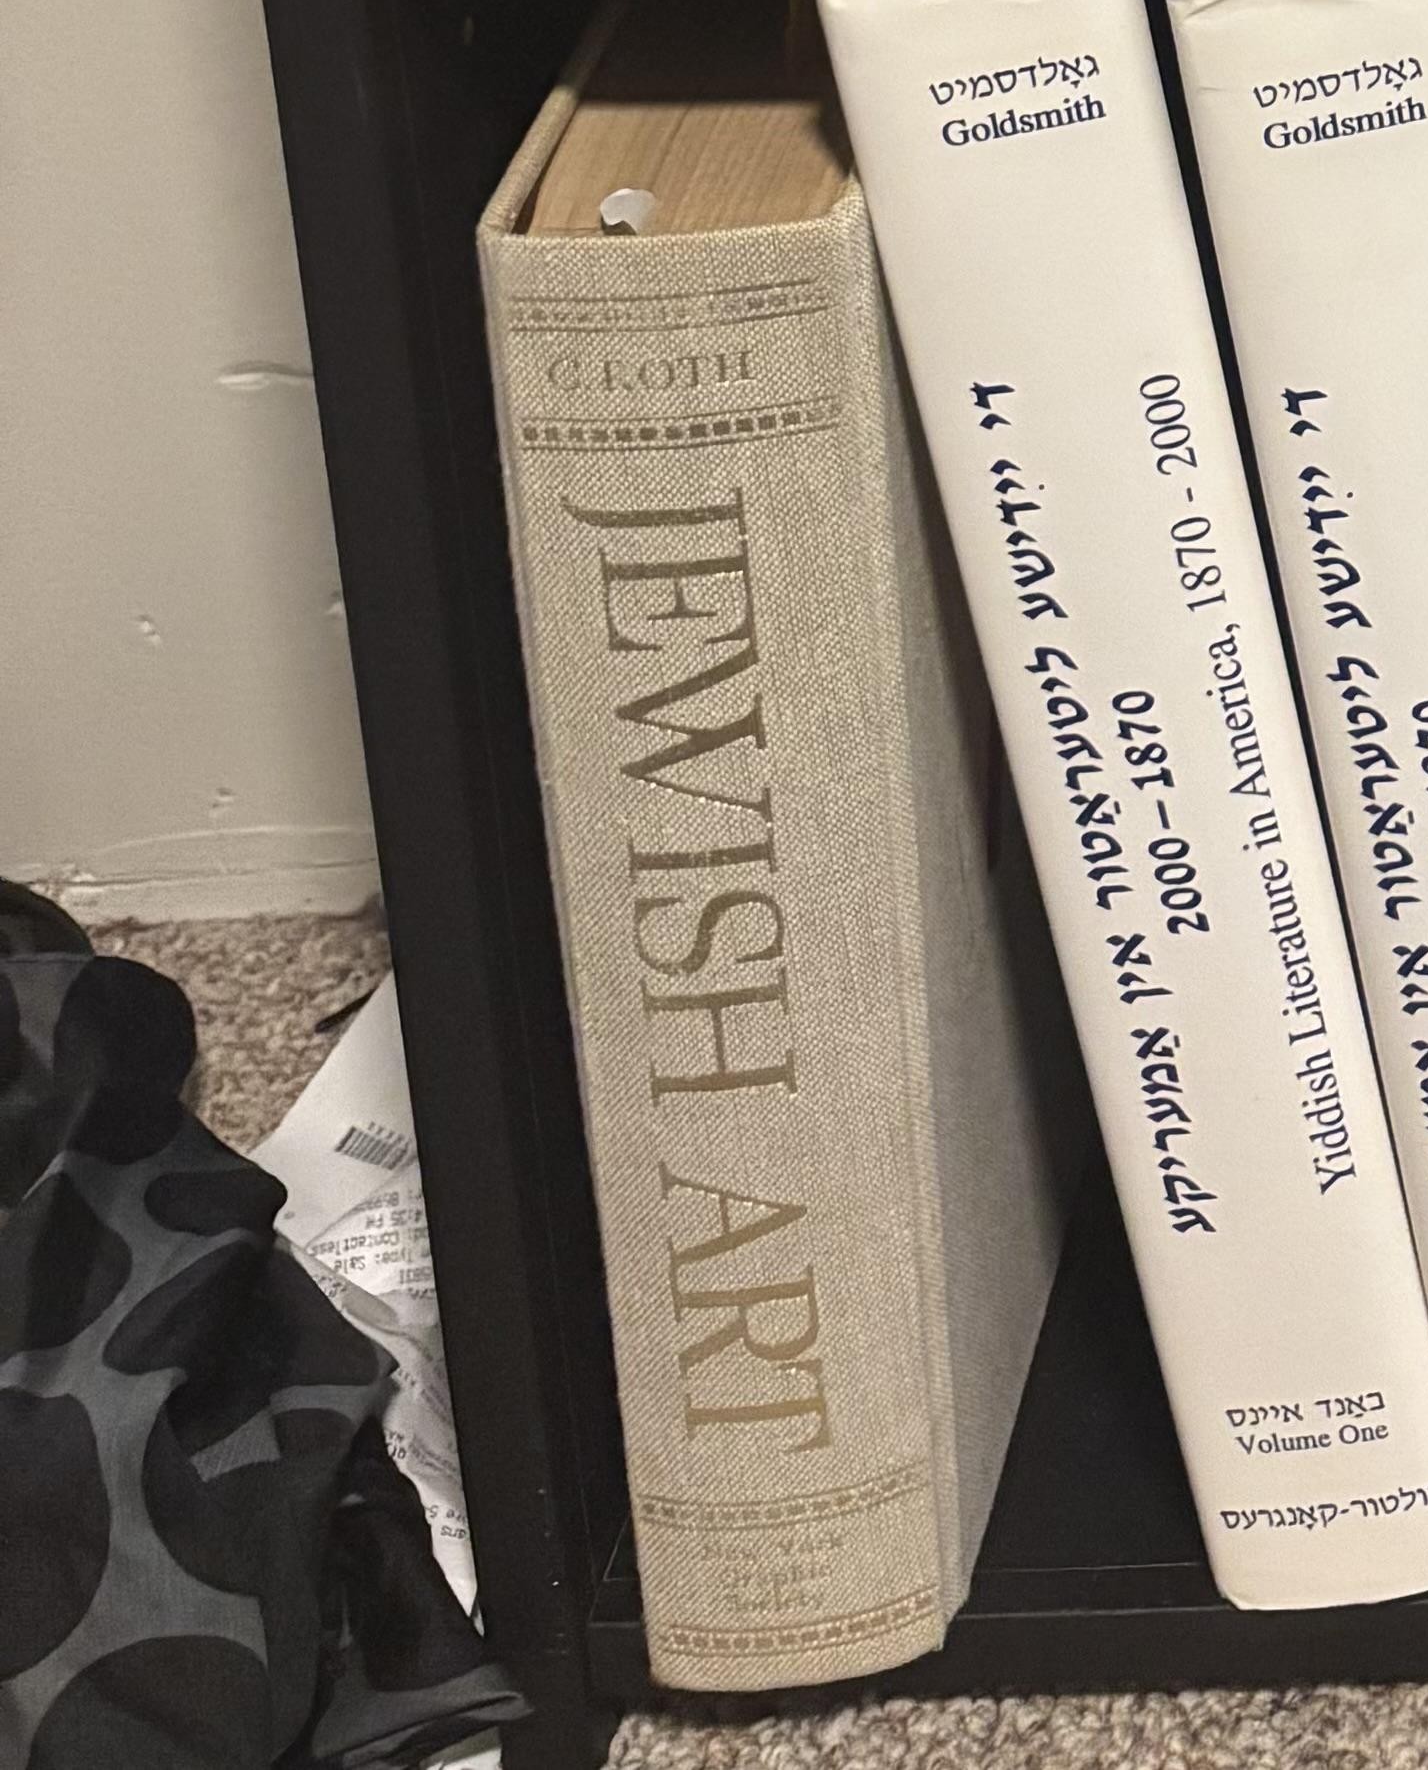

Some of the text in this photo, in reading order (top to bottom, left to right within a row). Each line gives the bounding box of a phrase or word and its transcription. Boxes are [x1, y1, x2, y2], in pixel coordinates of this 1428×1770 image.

[941, 95, 1106, 148] Goldsmith
[1262, 96, 1427, 150] Goldsmith
[968, 380, 1018, 430] די
[1106, 932, 1174, 1005] אין
[560, 485, 831, 1456] JEWISH ART
[334, 1257, 365, 1272] Sale
